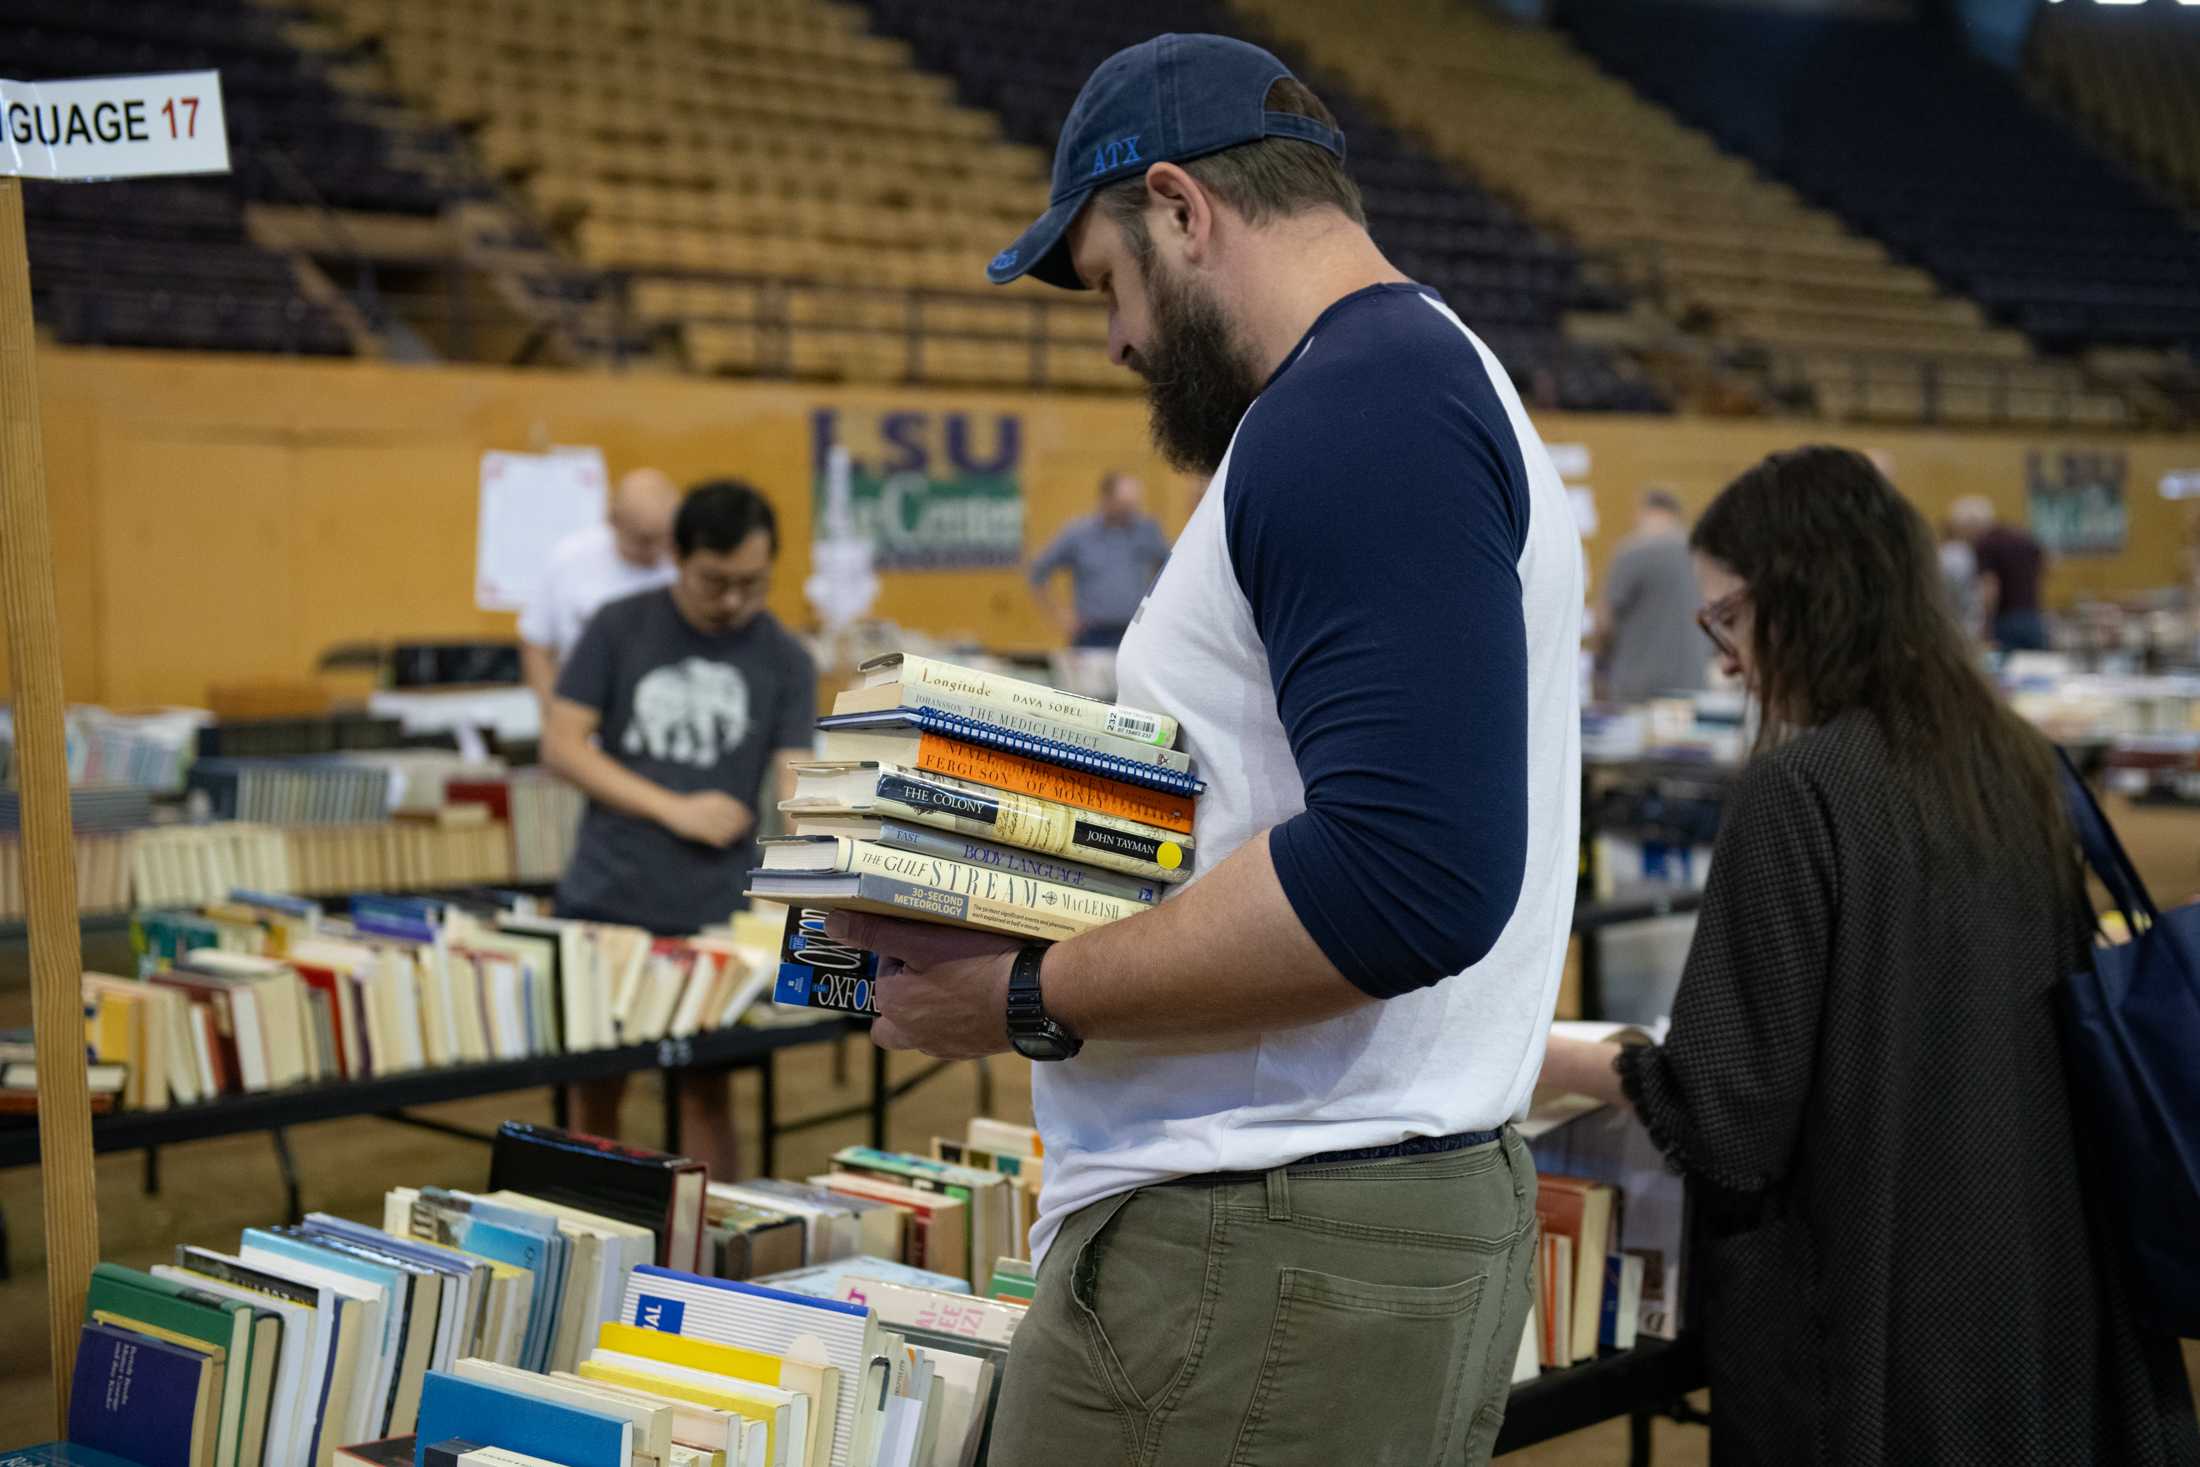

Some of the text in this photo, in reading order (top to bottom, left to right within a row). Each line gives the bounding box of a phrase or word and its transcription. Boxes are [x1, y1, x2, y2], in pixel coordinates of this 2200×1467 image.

[161, 97, 199, 138] 17
[1090, 135, 1143, 177] ATX
[811, 408, 1023, 475] LSU
[921, 666, 993, 698] Longitude
[916, 694, 961, 711] JOHANSSON
[1012, 693, 1083, 717] DAVA SOBEL
[969, 706, 1100, 749] THE MEDICI EFFECT
[1106, 711, 1118, 732] 232
[926, 754, 1008, 785] FERGUSON
[904, 785, 984, 815] THE COLONY
[1026, 781, 1104, 809] OF MONEY
[1086, 830, 1156, 855] JOHN TAYMAN
[963, 844, 1087, 885] BODY LANGUAGE
[862, 851, 883, 865] THE
[883, 855, 929, 877] GULF
[929, 859, 1038, 909] STREAM
[894, 893, 963, 917] METEOROLOGY
[911, 887, 964, 906] 30-SECOND
[642, 1303, 663, 1330] AL
